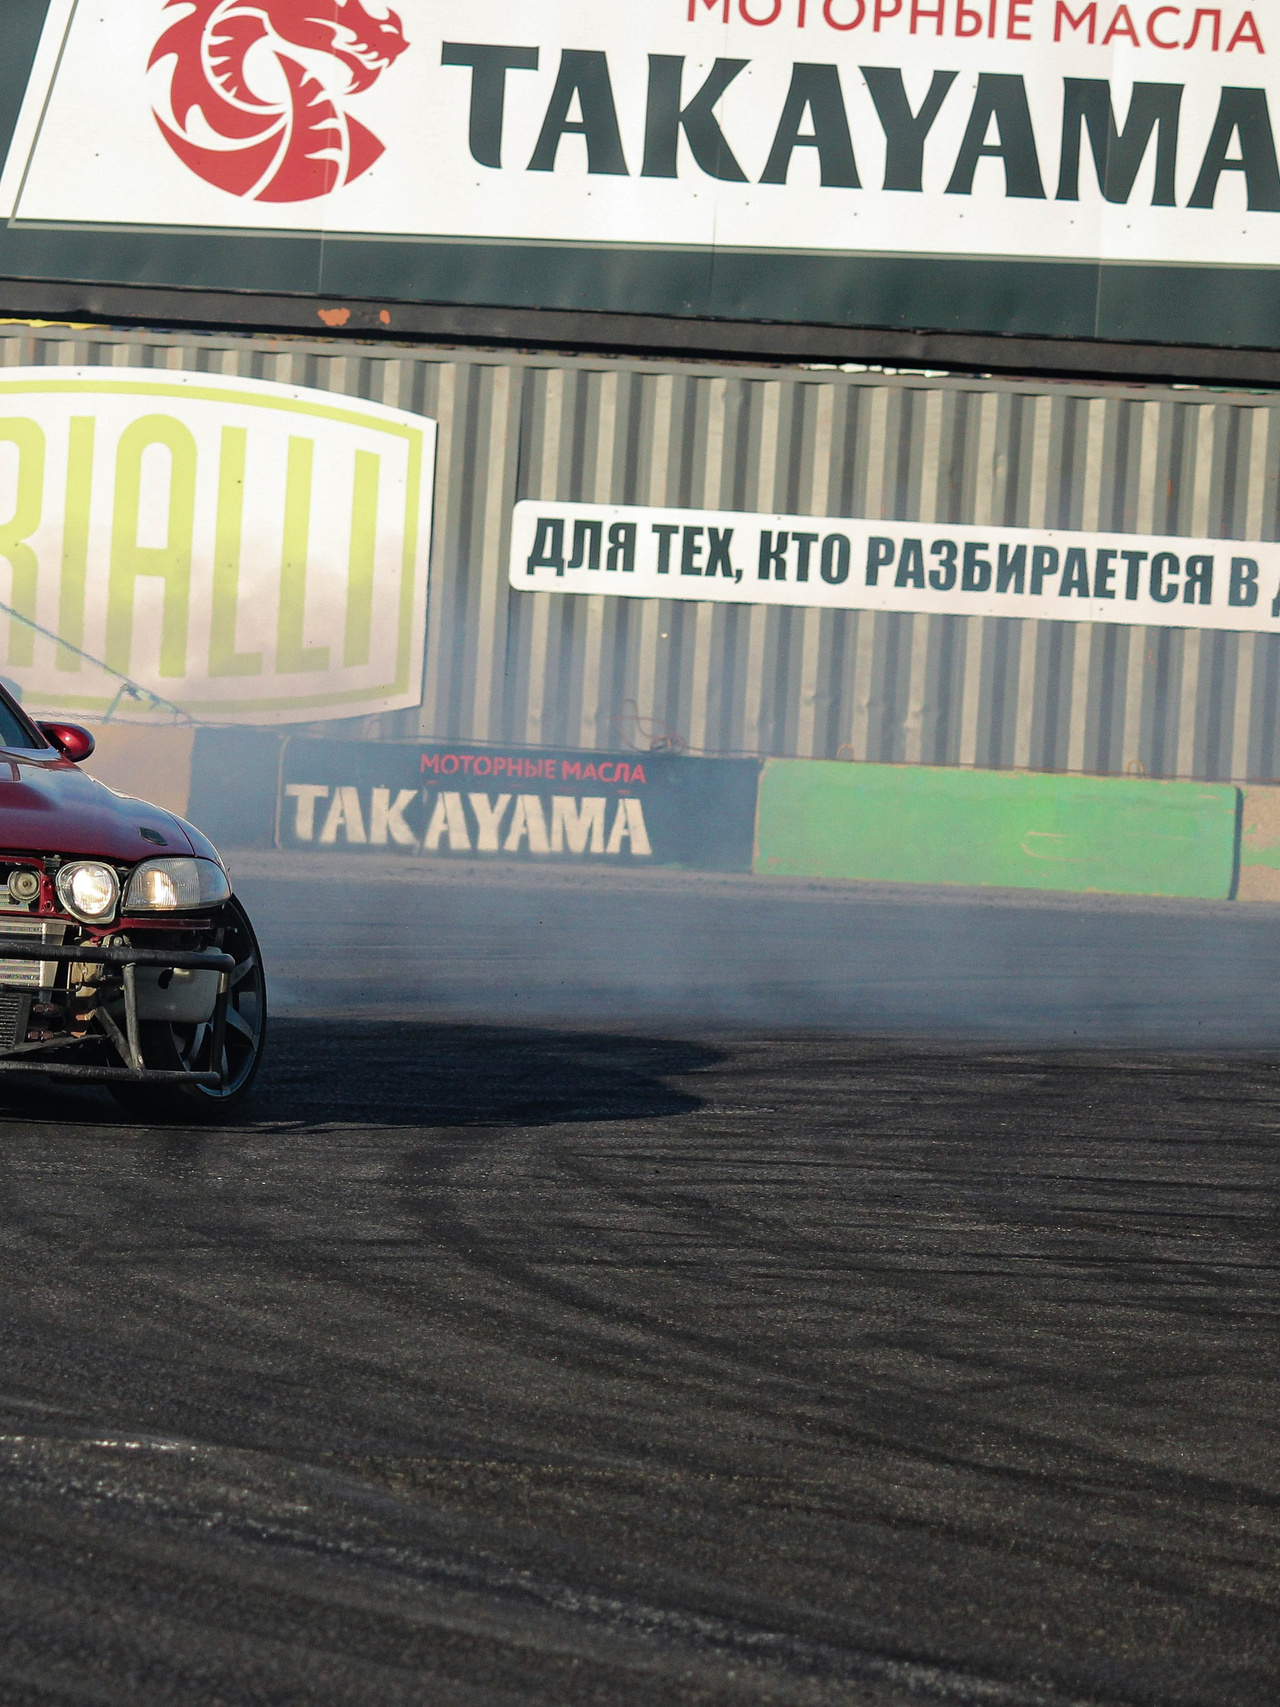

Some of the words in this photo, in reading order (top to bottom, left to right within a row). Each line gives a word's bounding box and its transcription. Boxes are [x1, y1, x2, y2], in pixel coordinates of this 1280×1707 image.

[1053, 0, 1266, 54] МАСЛА
[441, 41, 1280, 213] TAKAYAMA
[526, 517, 637, 577] ДЛЯ
[652, 523, 743, 584] ТЕХ,
[758, 530, 851, 585] КТО
[865, 535, 1214, 606] РАЗБИРАЕТСЯ
[1228, 556, 1259, 607] В
[421, 753, 557, 779] МОТОРНЫЕ
[561, 760, 647, 784] МАСЛА
[285, 783, 652, 856] TAKAYAMA
